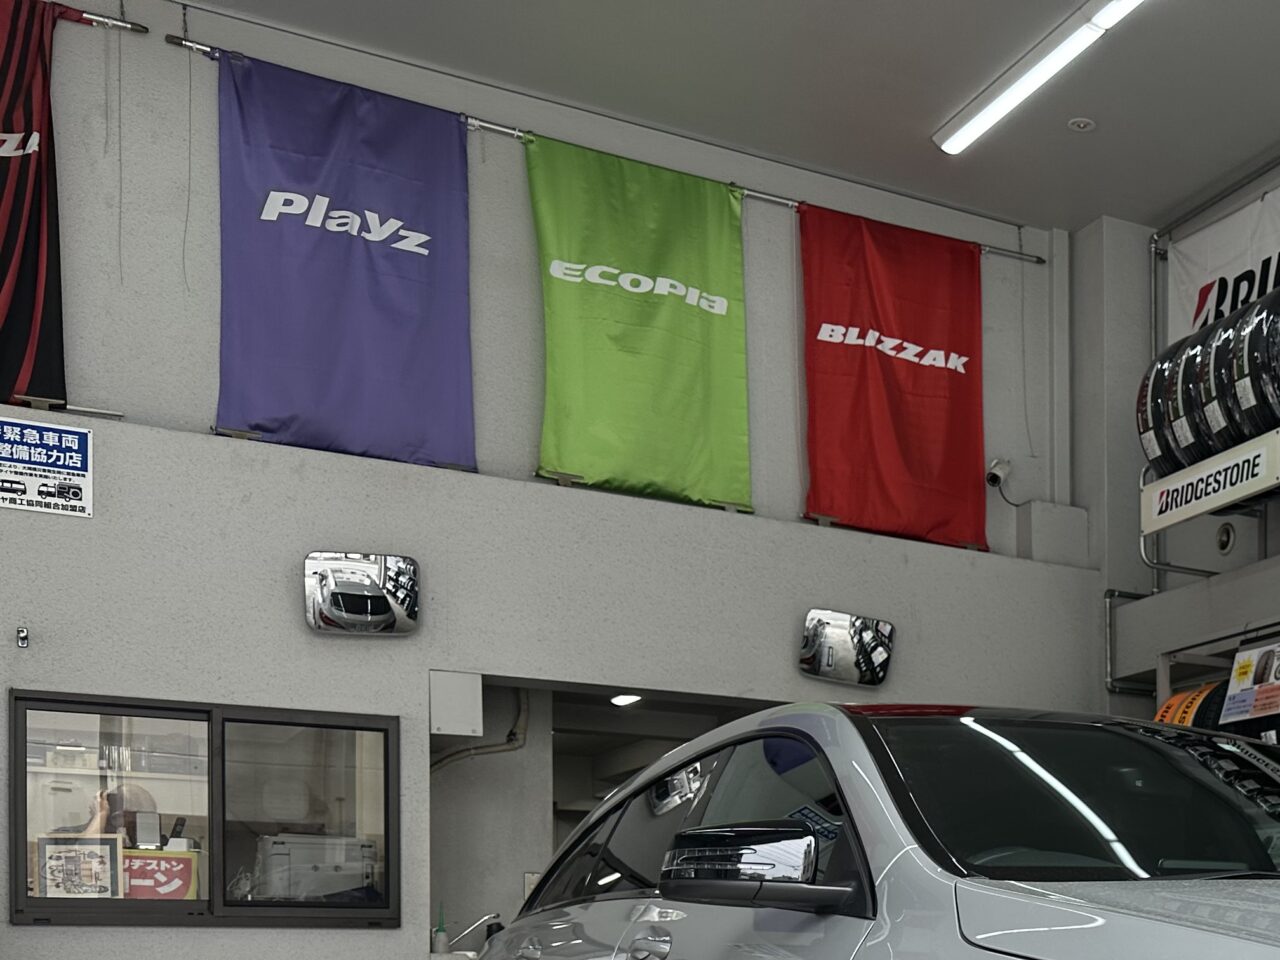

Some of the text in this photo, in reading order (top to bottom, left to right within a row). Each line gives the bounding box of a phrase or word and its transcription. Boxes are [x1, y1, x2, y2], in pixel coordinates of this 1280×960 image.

[259, 190, 432, 257] Playz
[817, 323, 969, 375] BLIZZAK
[0, 425, 79, 450] 緊急車両
[0, 442, 82, 468] 整備協力店
[1157, 453, 1262, 517] BRIDGESTONE
[124, 859, 184, 871] ヂストン
[124, 872, 183, 894] ーン
